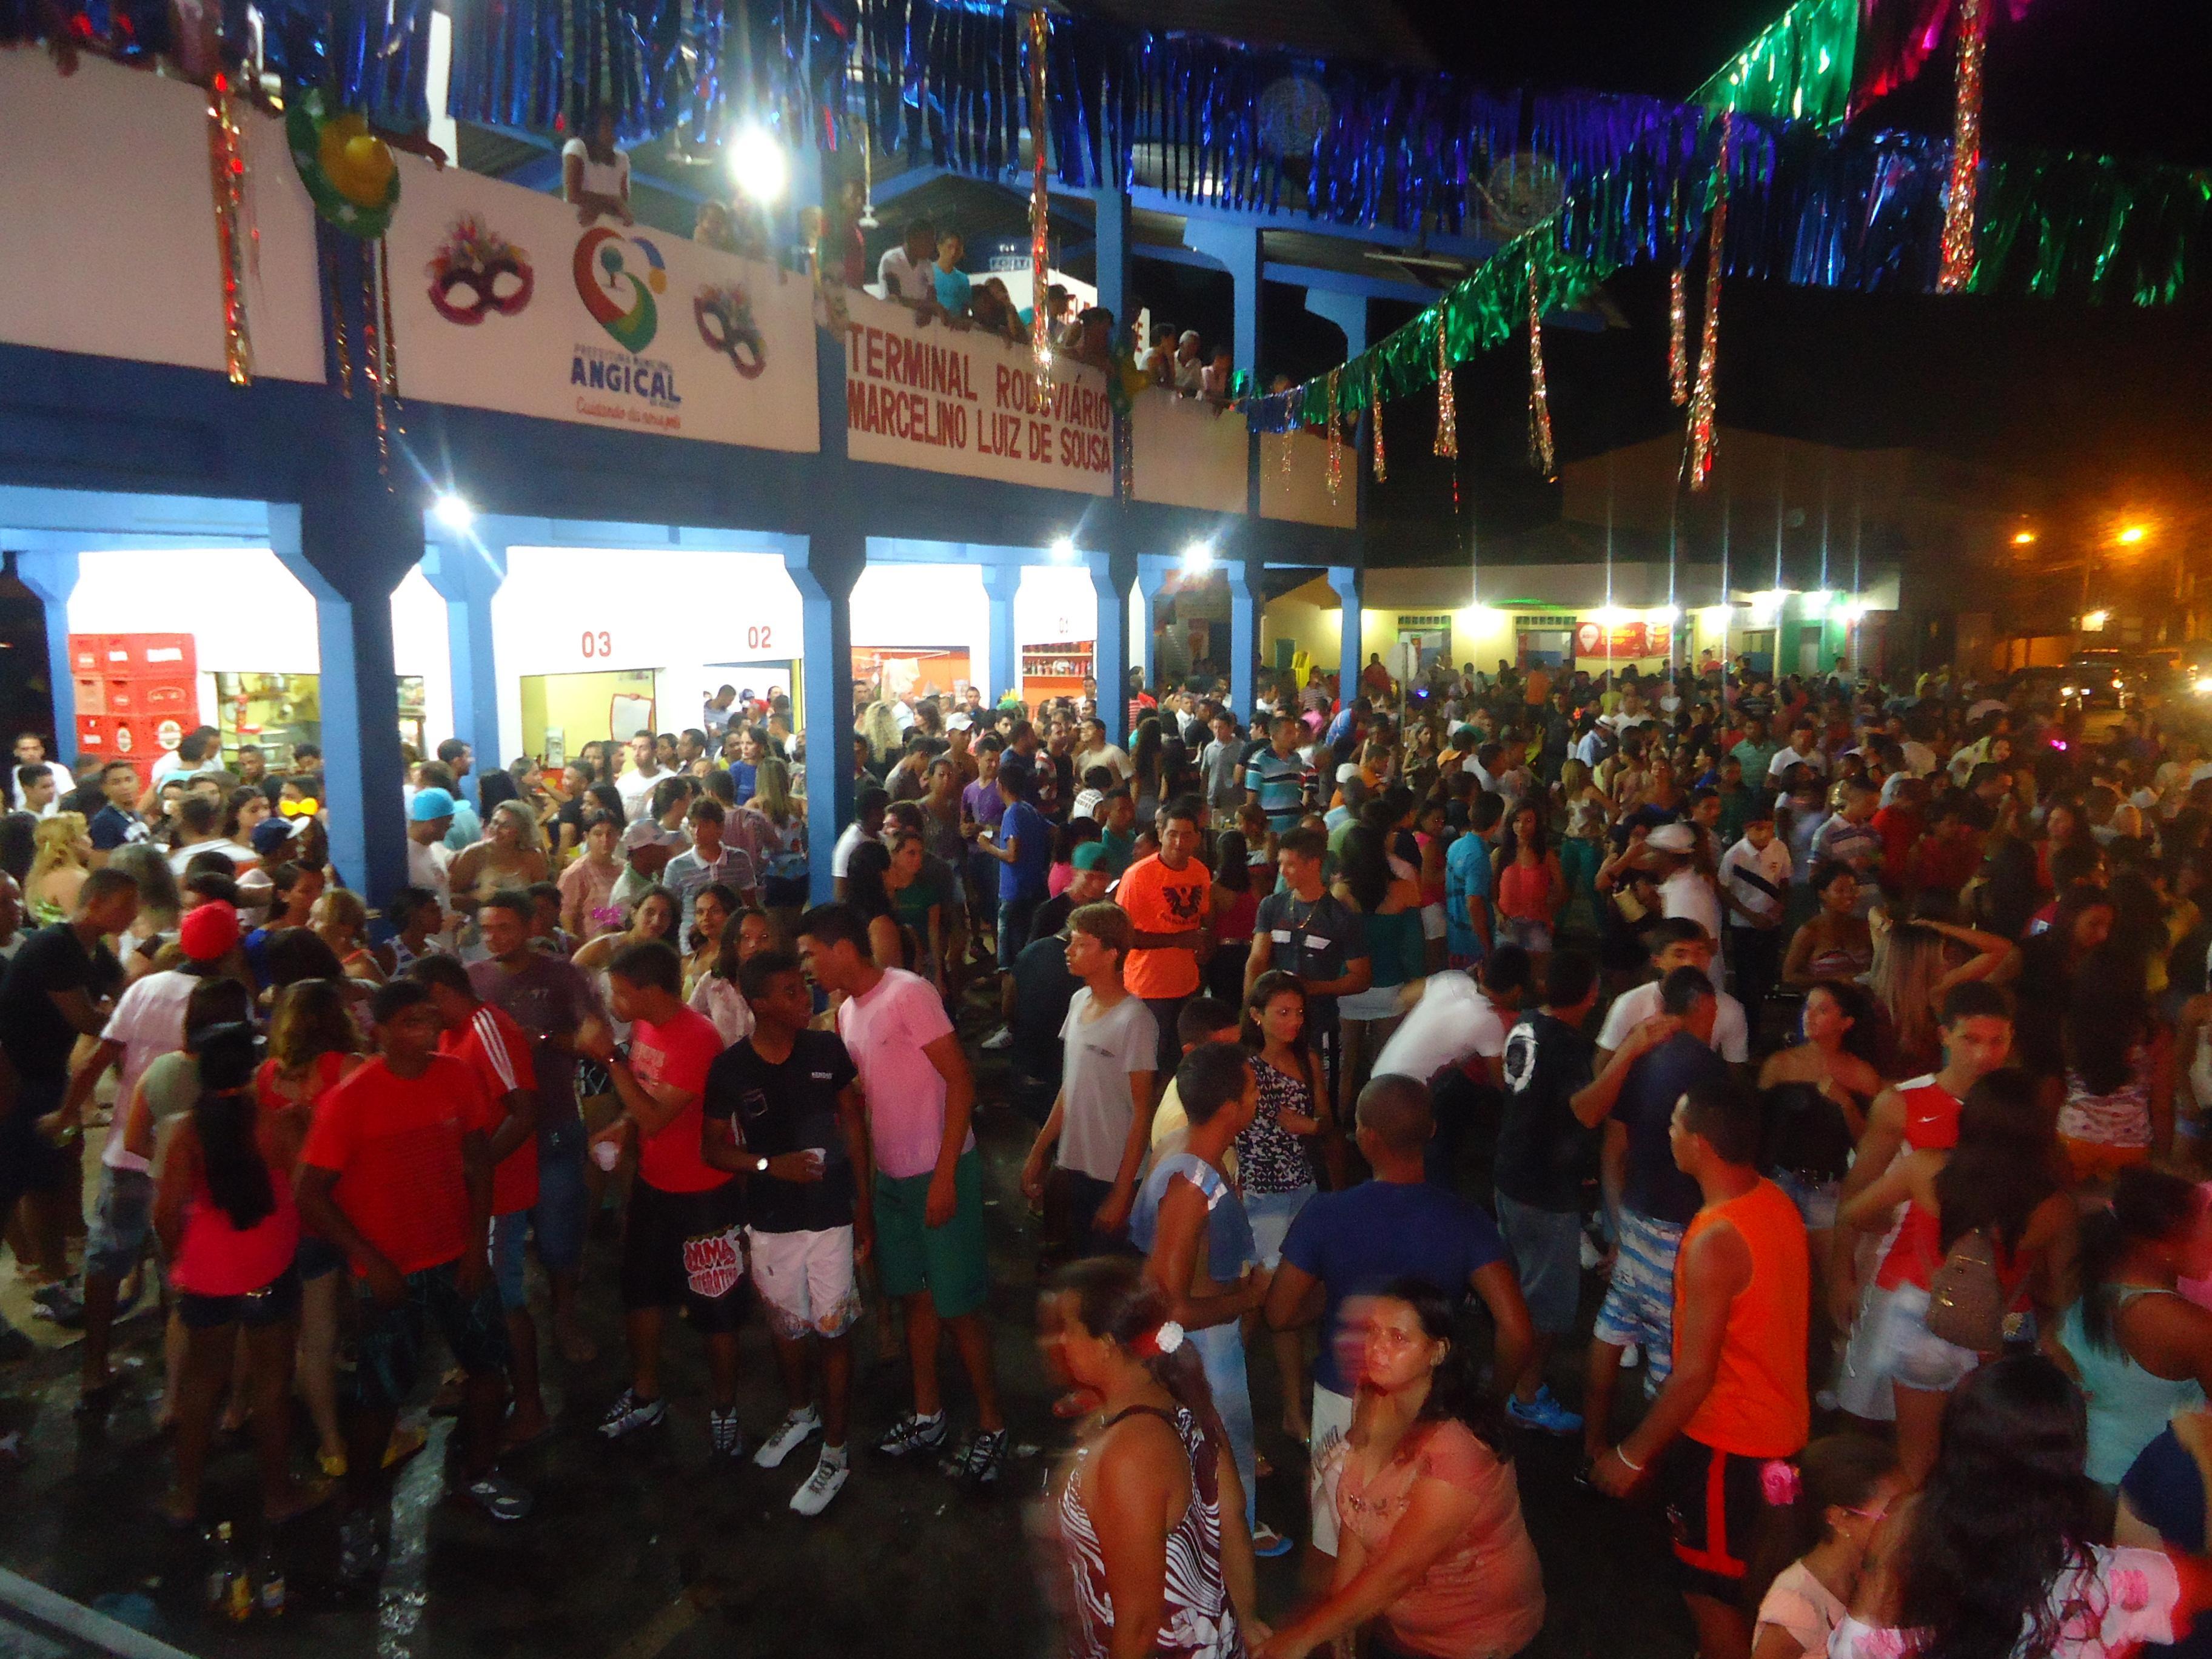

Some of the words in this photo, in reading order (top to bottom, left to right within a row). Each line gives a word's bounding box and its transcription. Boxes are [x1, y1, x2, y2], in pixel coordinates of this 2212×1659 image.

[571, 357, 682, 402] ANGICAL
[848, 321, 977, 401] TERMINAL
[848, 378, 967, 449] MARCELINO
[977, 409, 1022, 458] LUIZ
[1029, 420, 1052, 469] DE
[1061, 426, 1111, 475] SOUSA
[581, 631, 611, 658] 03
[748, 626, 771, 649] 02
